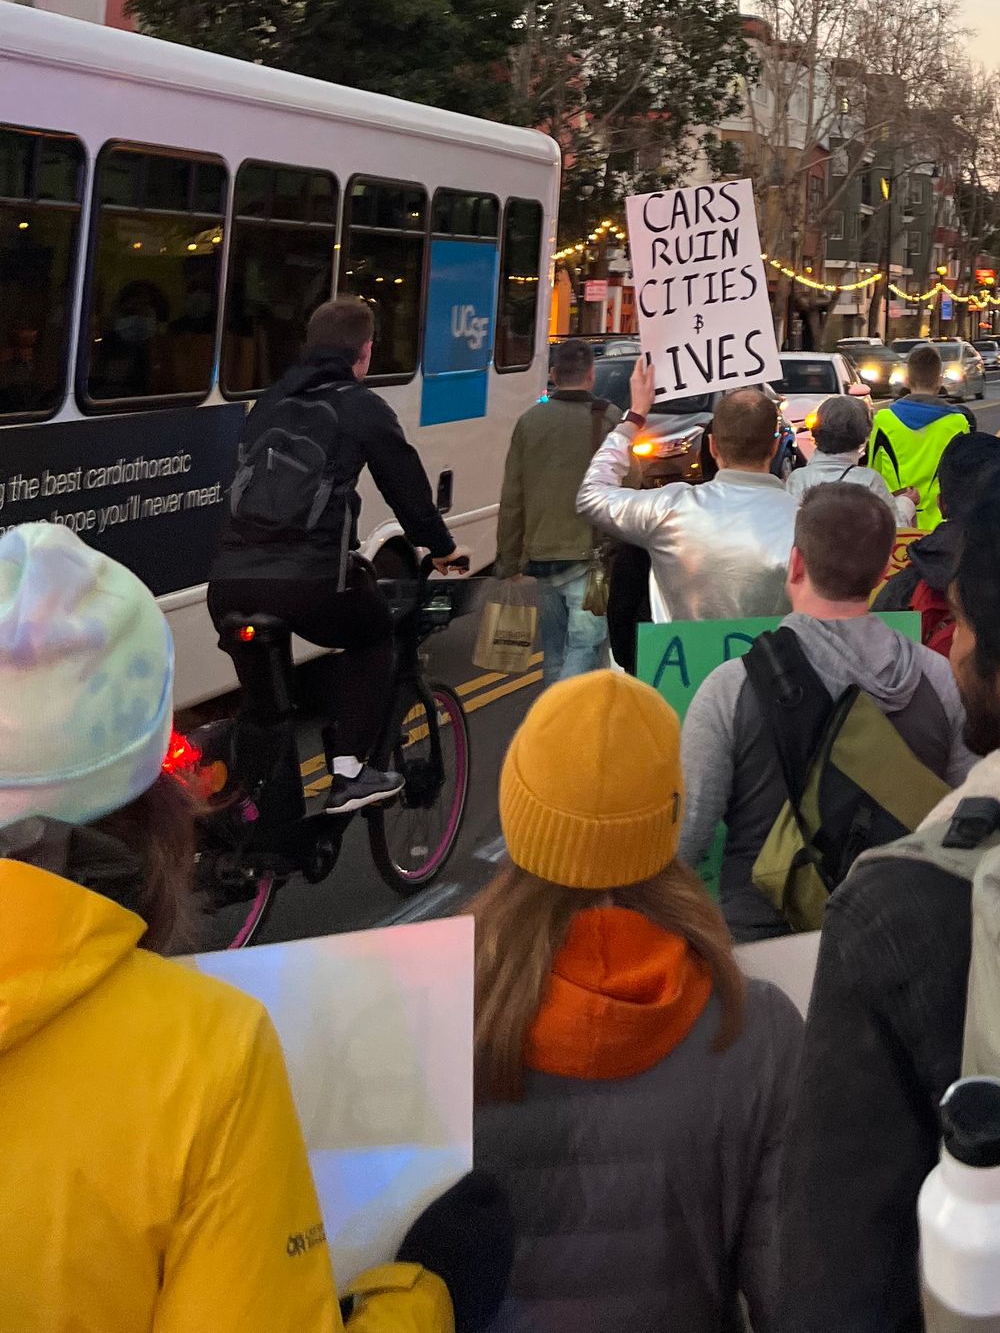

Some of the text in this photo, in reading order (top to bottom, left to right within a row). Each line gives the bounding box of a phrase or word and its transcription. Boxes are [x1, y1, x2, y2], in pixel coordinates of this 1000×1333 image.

[643, 182, 741, 233] CARS
[651, 227, 740, 269] RUIN
[639, 265, 758, 318] CITIES
[451, 304, 489, 350] UCSF
[645, 329, 766, 396] LIVES
[9, 473, 40, 502] the
[41, 466, 83, 496] best
[83, 449, 192, 490] cardiothoracic
[97, 495, 141, 535] you'll
[142, 492, 184, 518] never
[184, 481, 224, 509] meet.
